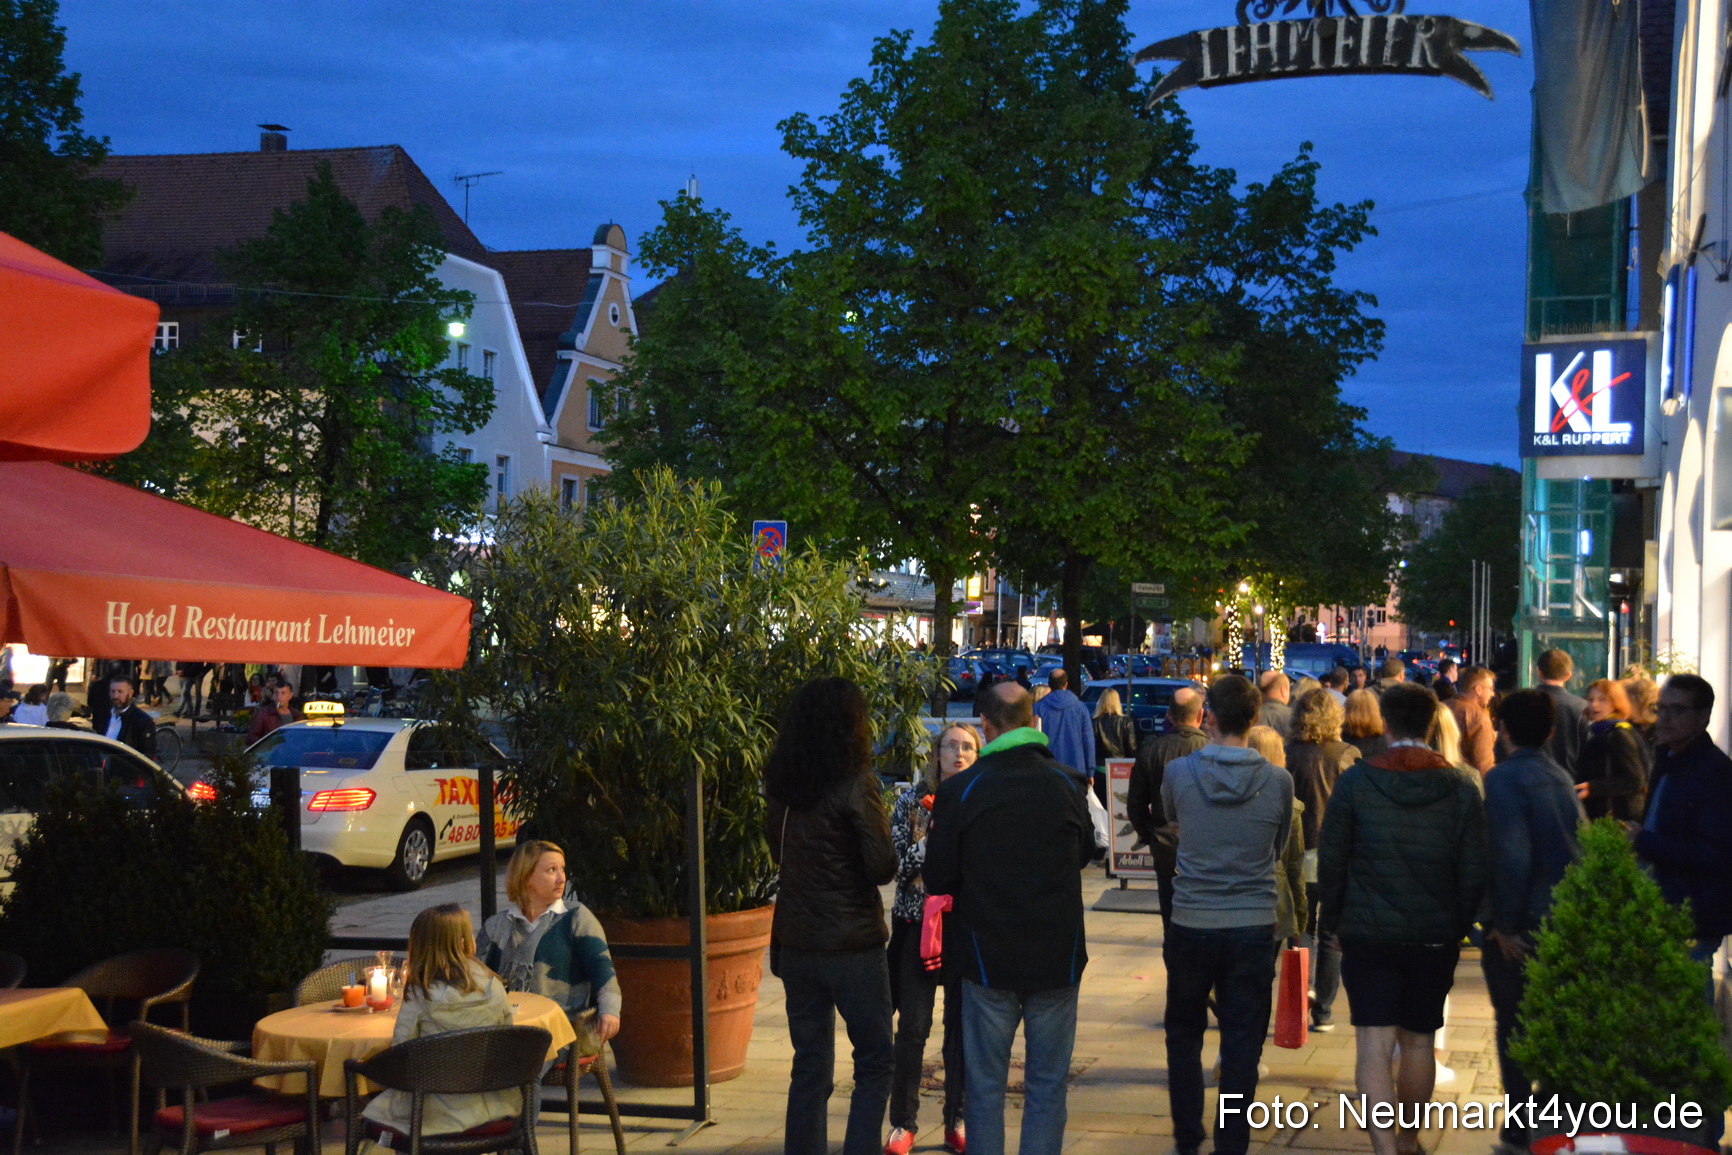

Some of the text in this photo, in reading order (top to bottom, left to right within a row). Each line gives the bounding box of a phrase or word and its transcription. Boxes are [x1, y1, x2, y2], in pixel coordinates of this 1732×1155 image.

[1198, 14, 1441, 80] LEHMEIER
[1535, 349, 1632, 433] K&L
[1533, 432, 1631, 446] K&L RUPPERT
[106, 601, 416, 647] Hotel Restaurant Lehmeier
